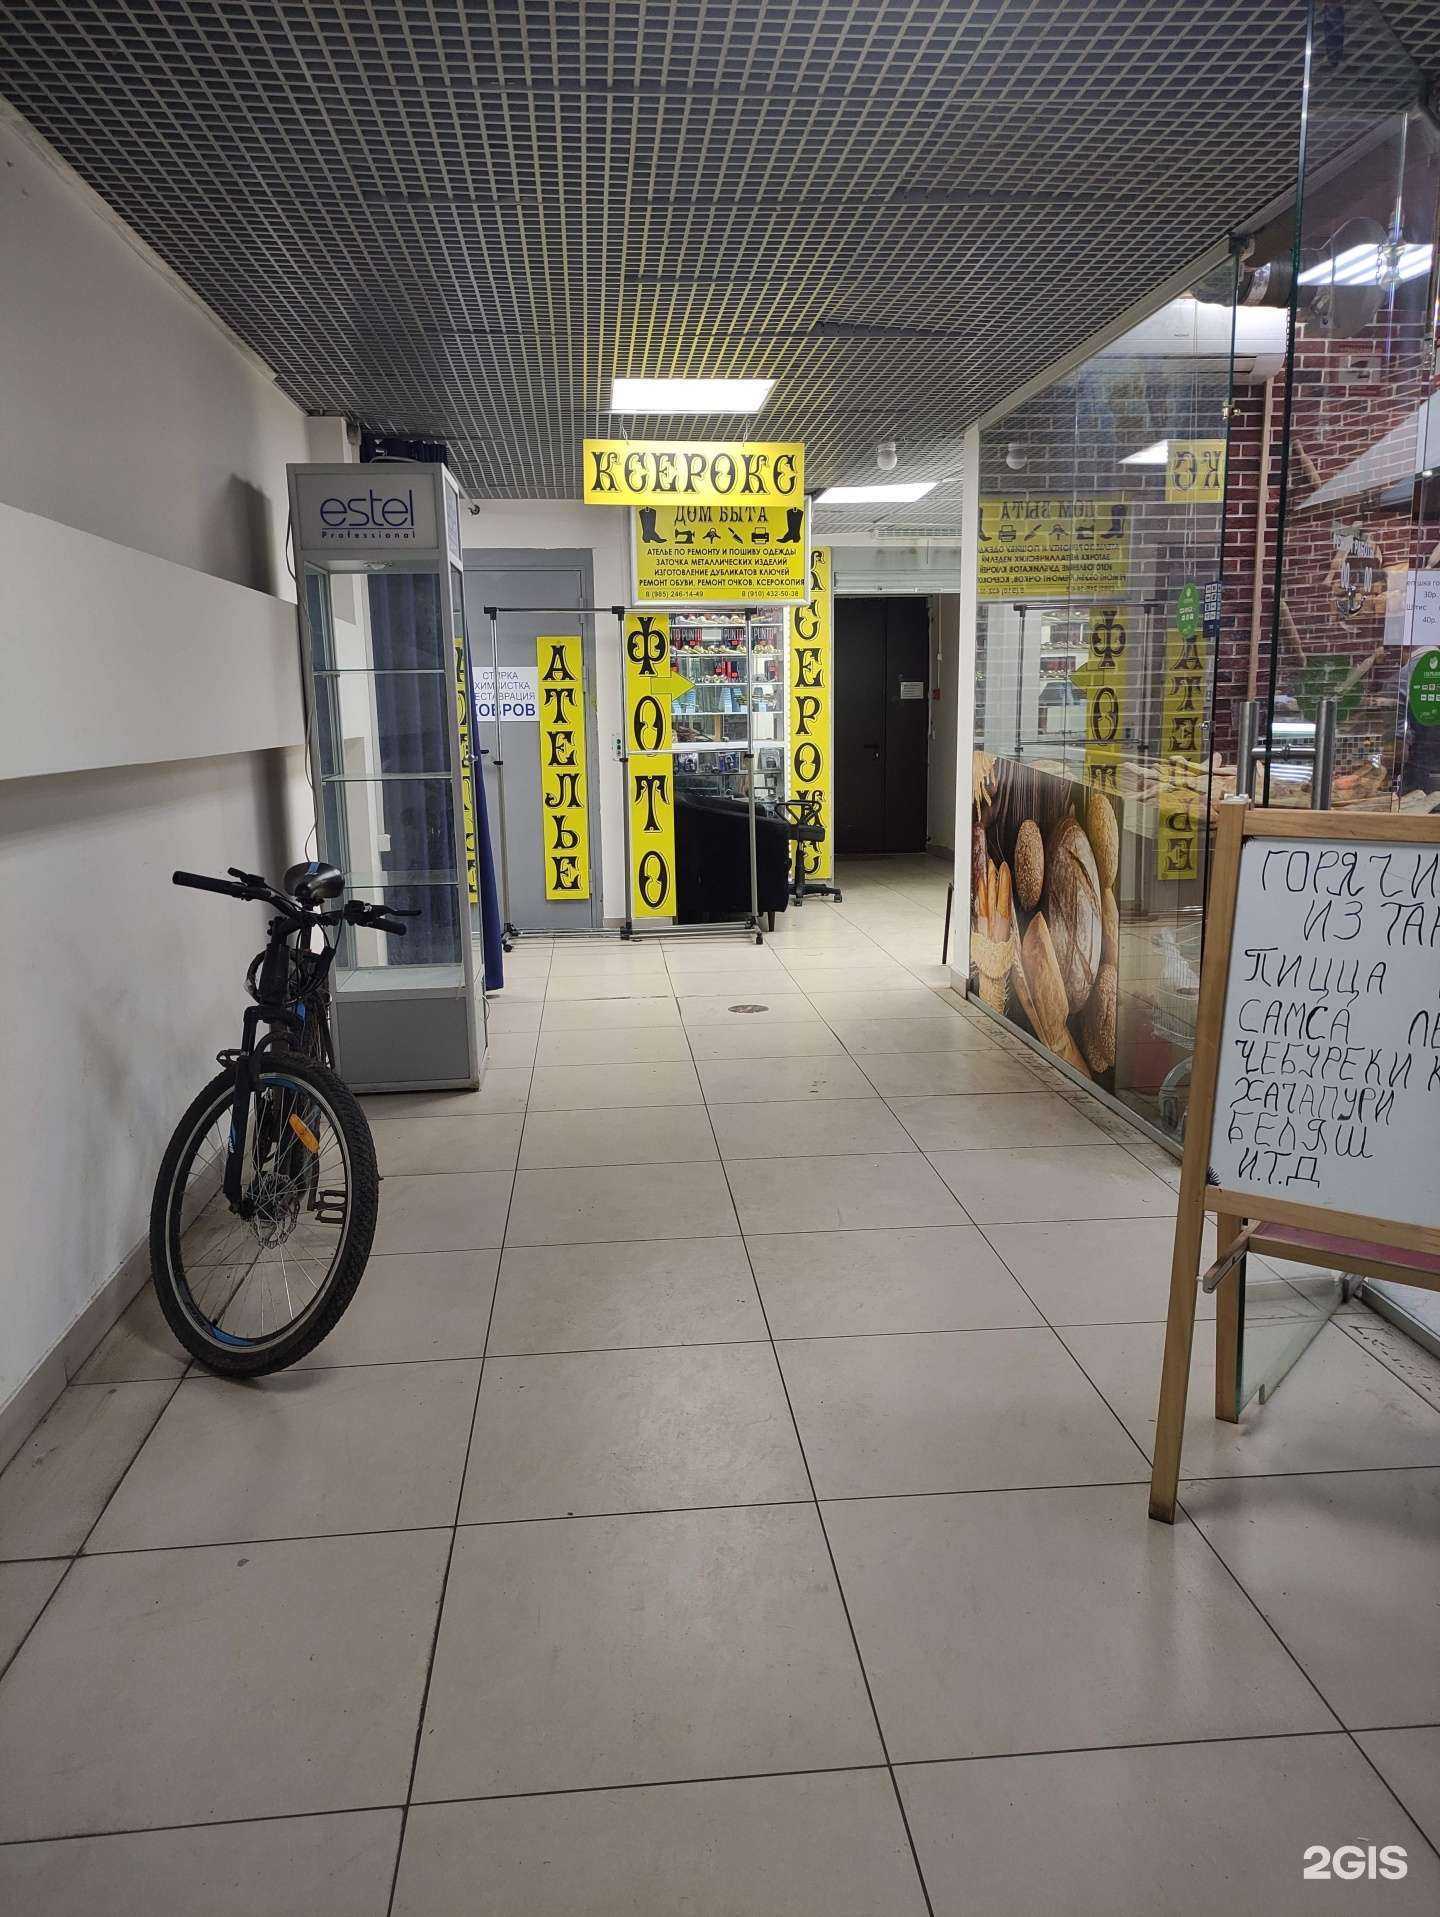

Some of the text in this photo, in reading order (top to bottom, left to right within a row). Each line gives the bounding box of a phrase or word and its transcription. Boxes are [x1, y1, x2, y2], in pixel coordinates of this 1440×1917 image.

[591, 451, 798, 495] КСЕРОКС
[320, 489, 414, 527] estel
[674, 506, 768, 526] ДОМ БЫТА
[321, 531, 415, 539] Professional
[647, 548, 796, 556] АТЕЛЬЕ ПО РЕМОНТУ И ПОШИВУ ОДЕЖДЫ
[655, 568, 789, 576] ИЗГОТОВЛЕНИЕ ДУБЛИКАТОВ КЛЮЧЕЙ
[656, 557, 787, 566] ЗАТОЧКА МЕТАЛЛИЧЕСКИХ ИЗДЕЛИЙ
[640, 579, 668, 587] РЕМОНТ
[698, 579, 725, 587] РЕМОНТ
[757, 579, 805, 587] КСЕРОКОПИЯ
[747, 591, 765, 599] (910)
[474, 681, 531, 690] ХИМИСТКА
[482, 671, 519, 680] СТРКА
[476, 703, 536, 717] ОВРОВ
[542, 644, 583, 891] АТЕЛЬЕ
[627, 616, 670, 909] ФОТО
[1304, 900, 1363, 942] ИЗ
[1244, 947, 1387, 1007] ПИЦЦА
[1239, 999, 1350, 1044] САМСА
[1235, 1040, 1412, 1089] ЧЕБУРЕКИ
[1229, 1077, 1395, 1126] ХАЧАПУРИ
[1228, 1110, 1373, 1158] БЕЛЯШ
[1238, 1147, 1320, 1188] И.Т.Д
